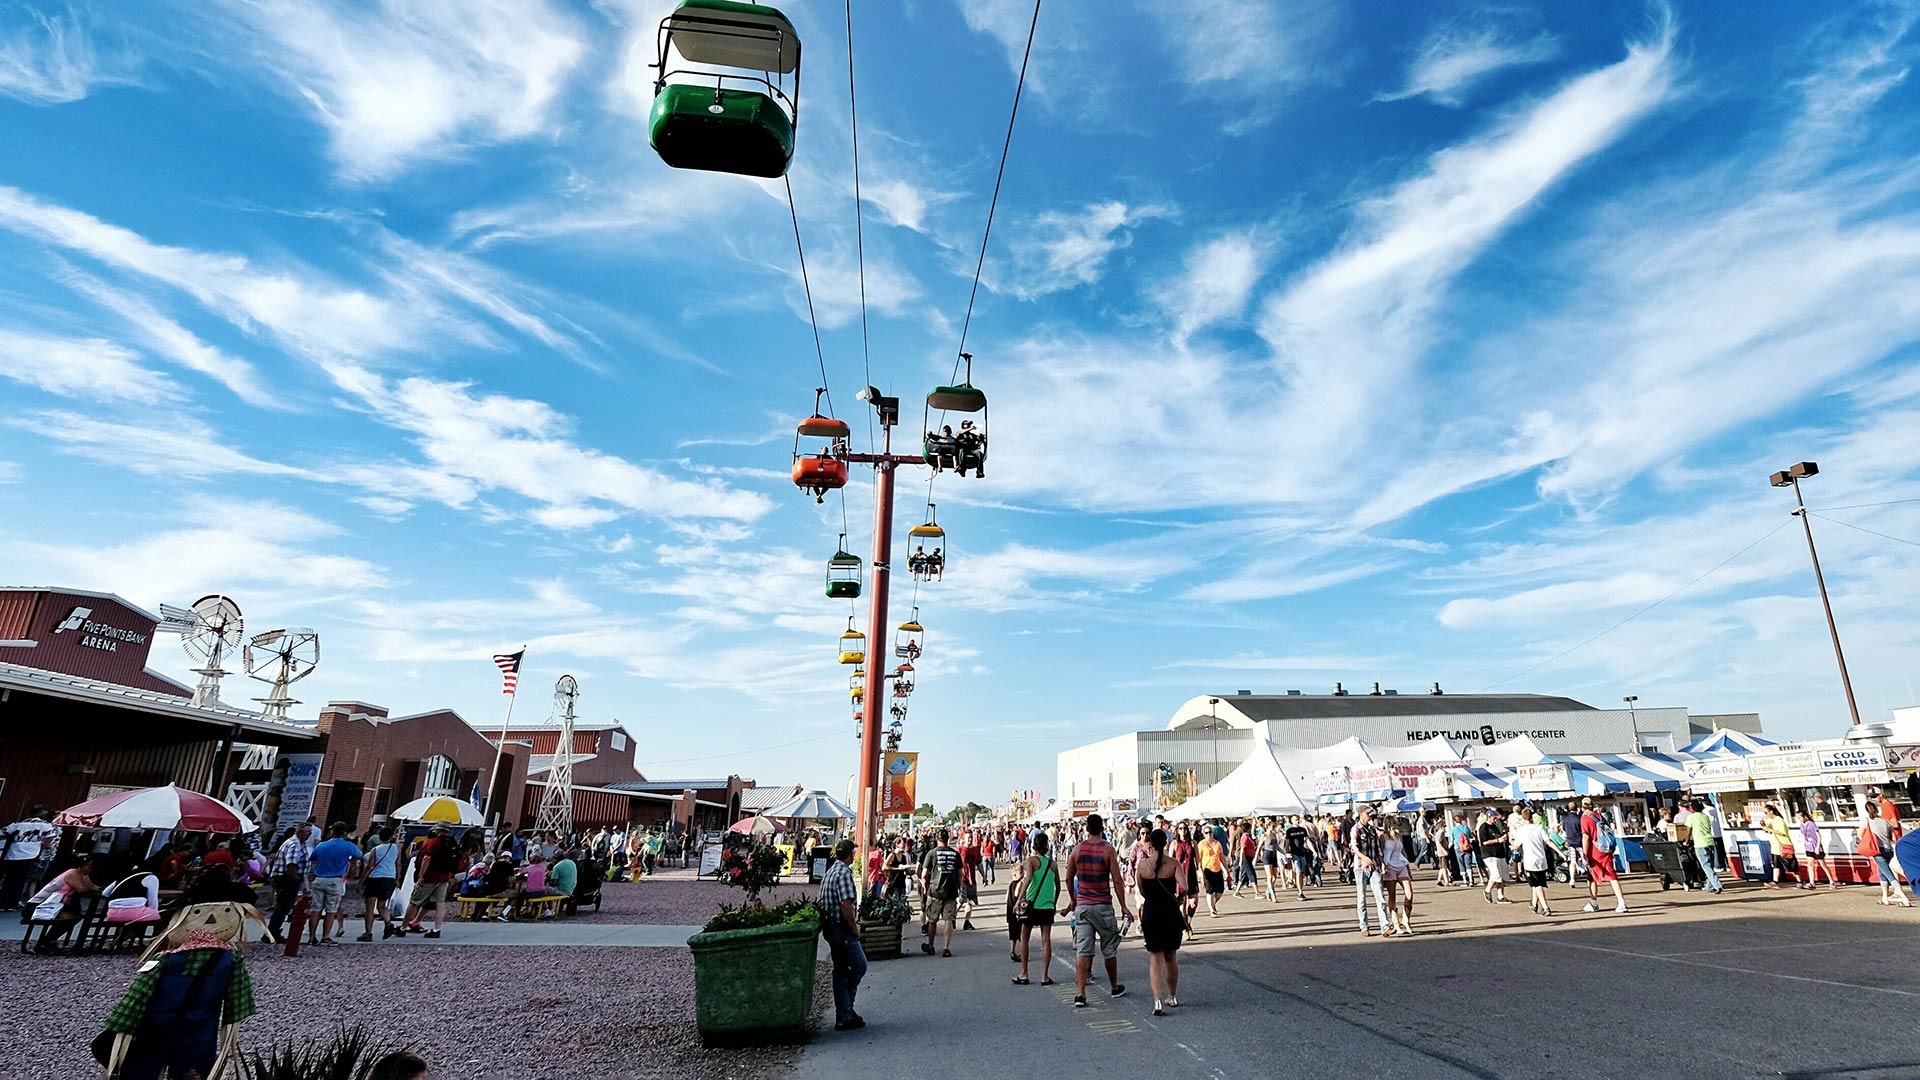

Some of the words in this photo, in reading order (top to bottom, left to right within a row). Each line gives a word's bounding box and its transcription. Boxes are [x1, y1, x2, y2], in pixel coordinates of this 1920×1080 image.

[82, 620, 99, 634] FIVE
[100, 624, 127, 641] POINTS
[126, 630, 147, 645] BANK
[81, 636, 117, 652] ARENA
[1406, 731, 1479, 741] HEARTLAND
[1531, 730, 1566, 739] CENTER
[1833, 751, 1865, 760] COLD
[1823, 757, 1879, 767] DRINKS
[1392, 765, 1429, 777] JUMBO
[1702, 766, 1721, 776] Corn
[1722, 765, 1743, 775] Dogs
[1835, 775, 1856, 784] Cheese
[1857, 774, 1877, 783] Sticks
[883, 775, 893, 809] Welcome
